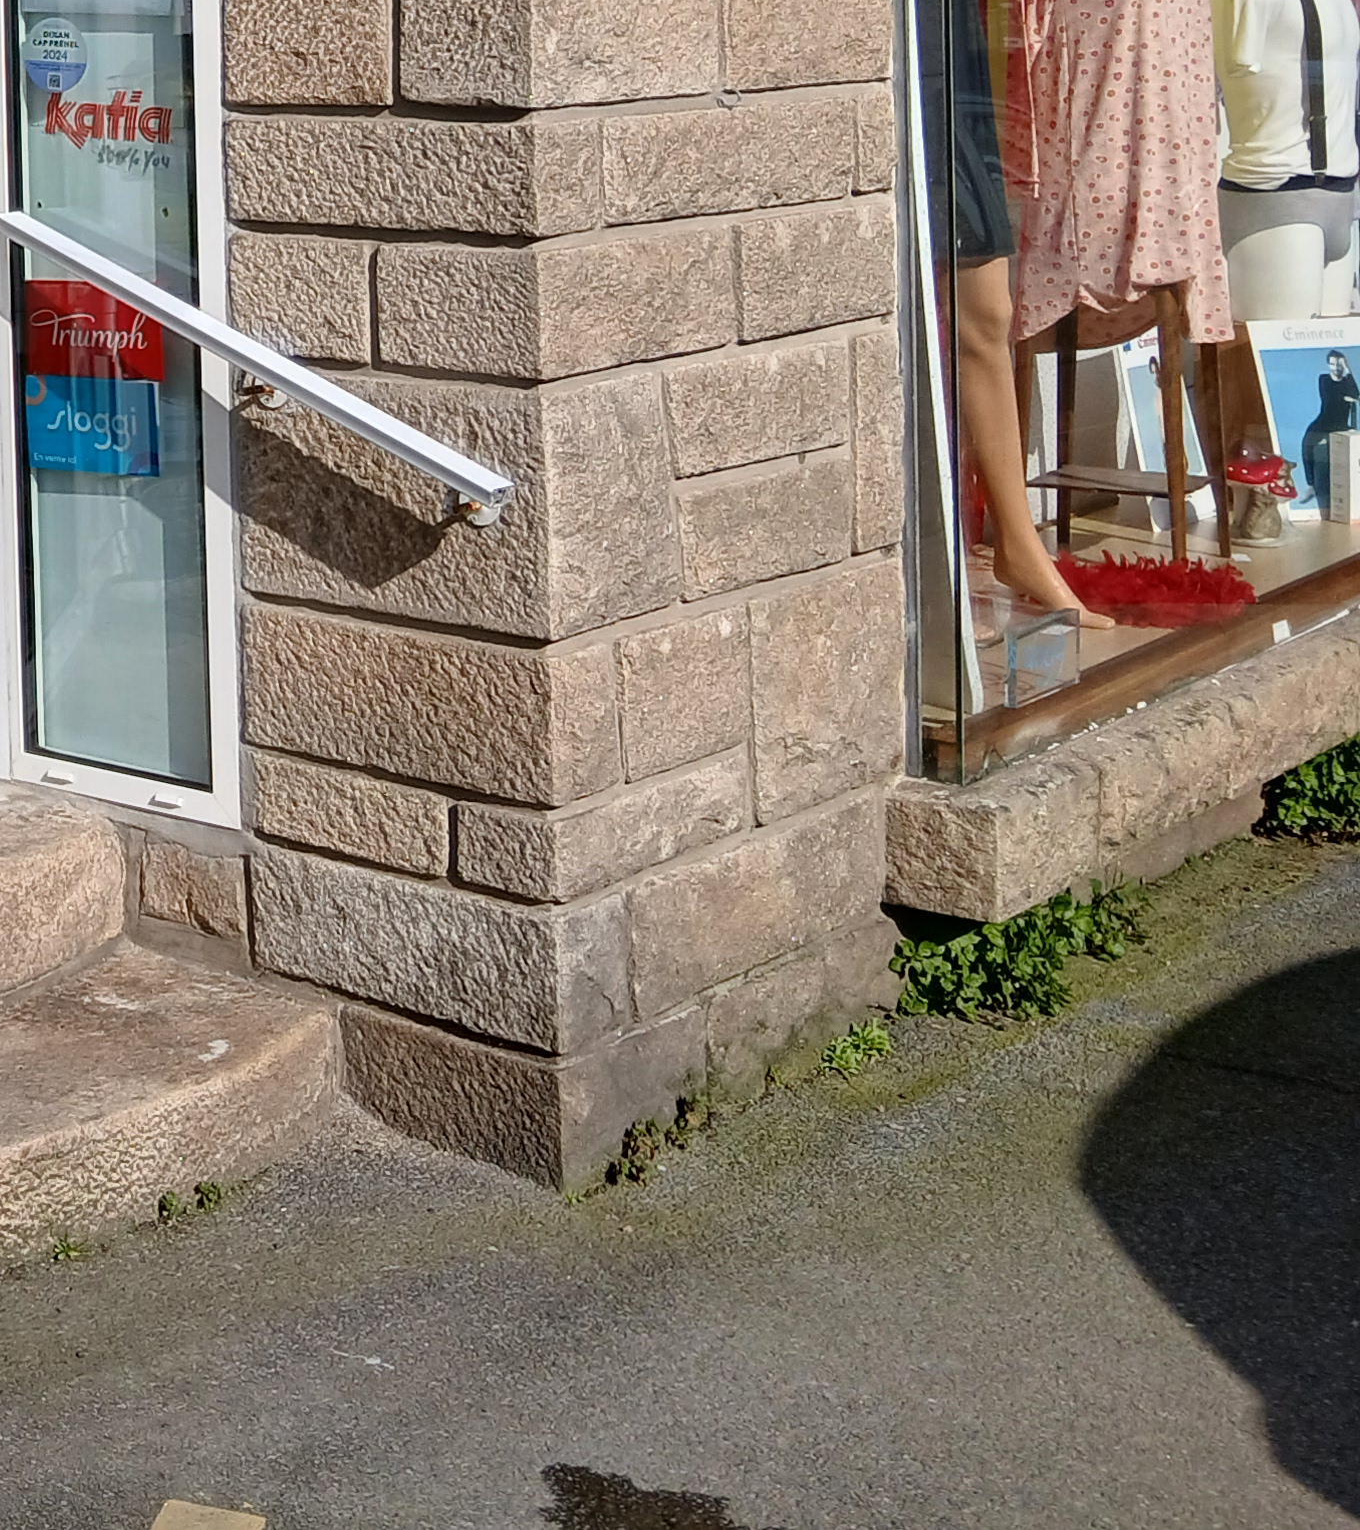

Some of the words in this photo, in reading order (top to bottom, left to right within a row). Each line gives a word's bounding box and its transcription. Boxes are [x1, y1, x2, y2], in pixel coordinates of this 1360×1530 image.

[43, 50, 67, 62] 2024
[45, 90, 172, 149] katia
[31, 309, 148, 363] Triumph
[1283, 327, 1345, 341] Eminence
[47, 401, 138, 452] sloggi
